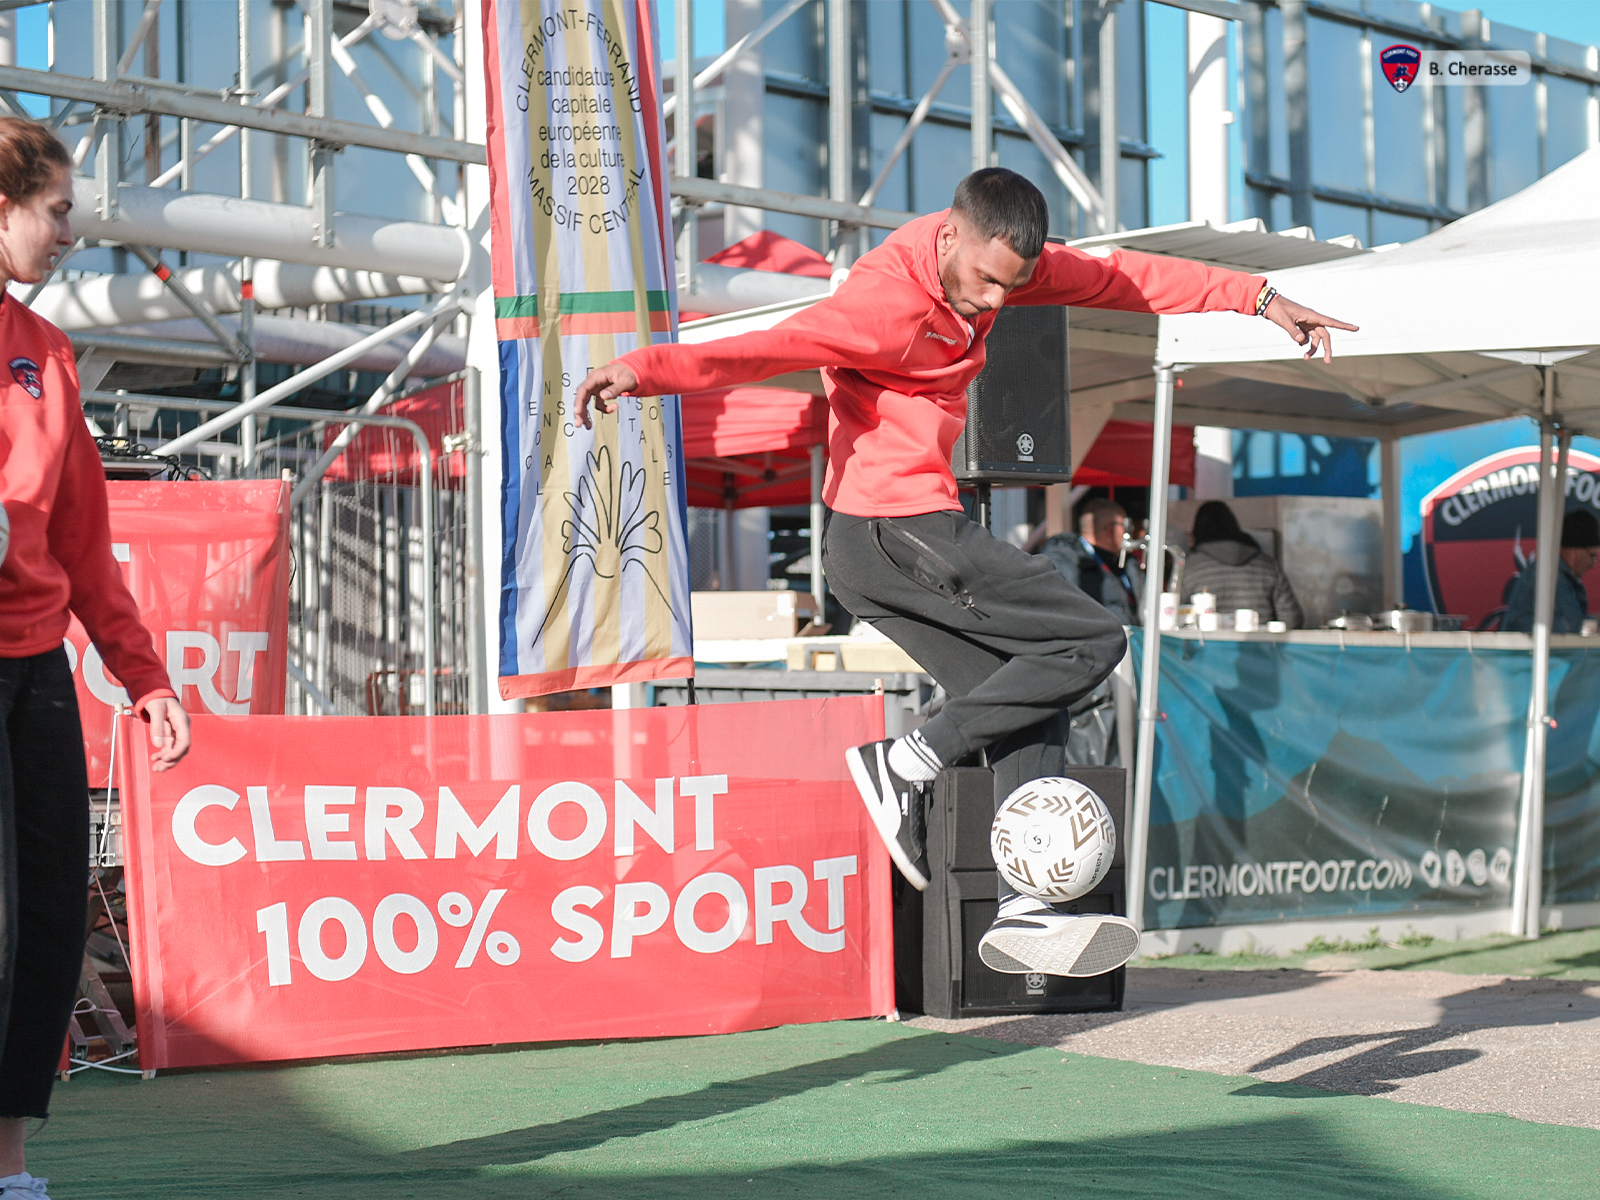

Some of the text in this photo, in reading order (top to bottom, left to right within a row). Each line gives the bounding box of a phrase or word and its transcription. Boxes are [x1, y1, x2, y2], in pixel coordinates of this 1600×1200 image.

[516, 8, 642, 113] CLERMONT-FERRAND
[537, 66, 615, 87] candidature
[551, 94, 611, 117] capitale
[540, 148, 625, 169] de la culture
[527, 166, 645, 235] MASSIF CENTRAL
[567, 175, 611, 196] 2028
[171, 773, 728, 866] CLERMONT
[1150, 858, 1413, 900] CLERMONTFOOT.COM
[256, 853, 857, 987] 100% SPORT
